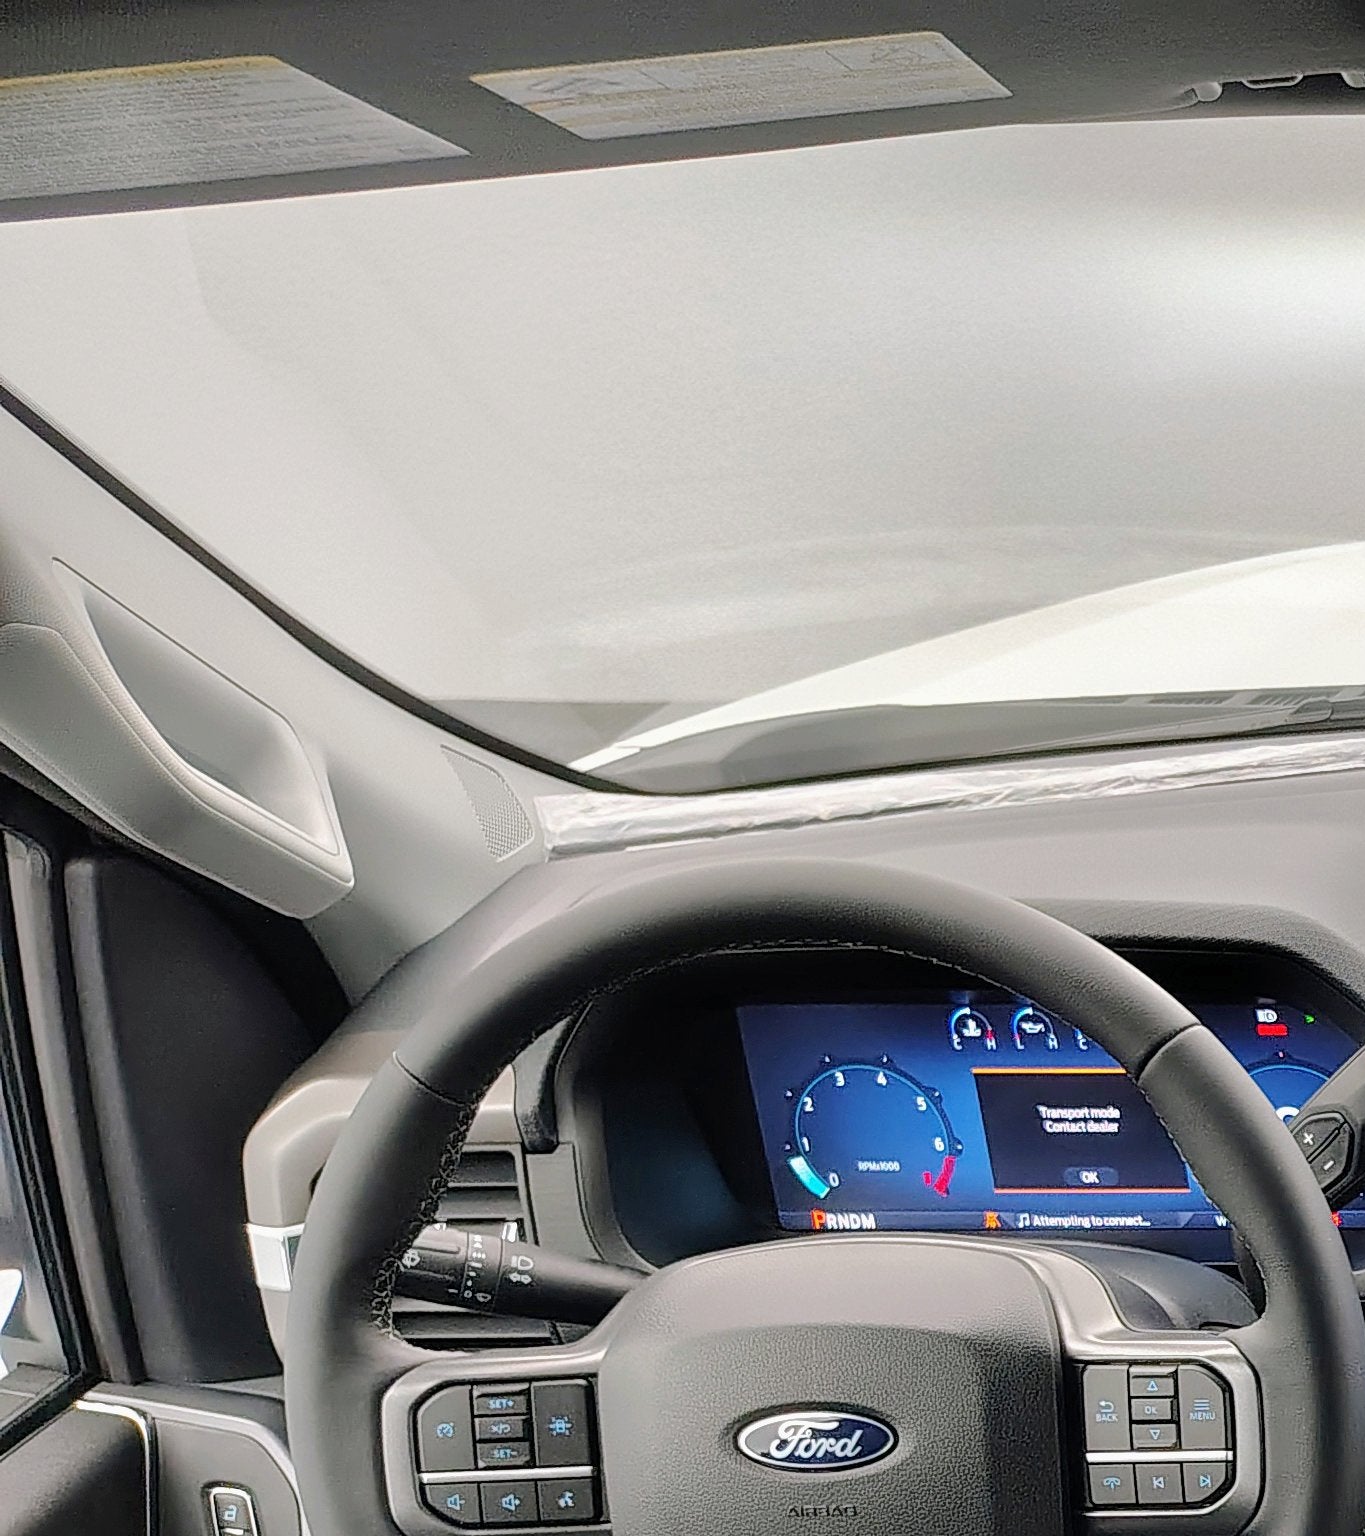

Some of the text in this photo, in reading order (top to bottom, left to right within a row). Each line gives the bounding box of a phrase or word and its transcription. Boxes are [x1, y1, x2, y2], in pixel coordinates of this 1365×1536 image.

[953, 1038, 962, 1050] C
[987, 1038, 996, 1050] H
[1017, 1038, 1024, 1050] L
[1049, 1038, 1058, 1050] H
[835, 1072, 845, 1086] 3
[877, 1071, 887, 1086] 4
[803, 1097, 814, 1112] 2
[916, 1097, 927, 1111] 5
[1037, 1105, 1120, 1120] Transport mode
[1043, 1120, 1119, 1133] Contact dealer
[802, 1136, 810, 1151] 1
[934, 1137, 944, 1151] 6
[828, 1172, 840, 1187] 0
[1080, 1171, 1099, 1184] OK
[1033, 1215, 1089, 1228] Attempting
[1091, 1215, 1102, 1226] to
[1144, 1405, 1157, 1415] OK
[1189, 1412, 1216, 1421] MENU
[1096, 1413, 1118, 1422] BACK
[769, 1420, 863, 1459] Ford
